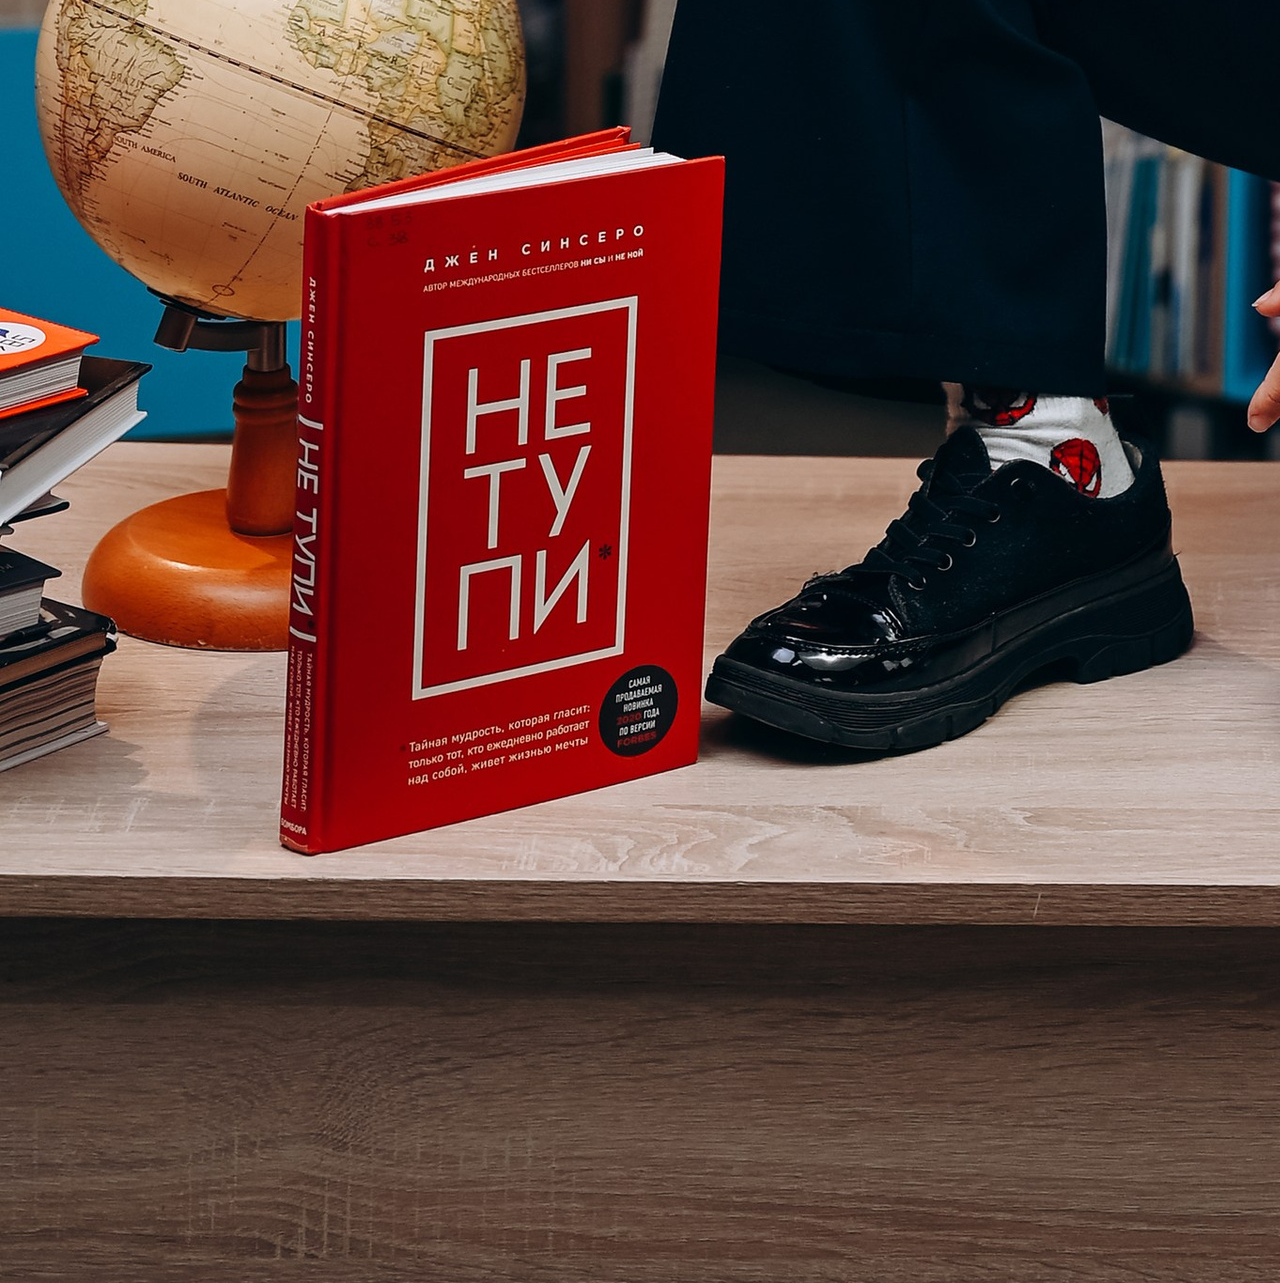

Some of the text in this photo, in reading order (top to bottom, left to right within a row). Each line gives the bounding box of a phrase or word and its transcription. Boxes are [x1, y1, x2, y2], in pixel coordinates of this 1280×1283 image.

[113, 133, 176, 163] SOUTH AMERICA
[177, 171, 299, 223] SOUTH ATLANTIC OCEAN
[423, 247, 644, 293] АВТОР МЕЖДУНАРОДНЫХ БЕСТСЕЛЛЕРОВ НИ СЫ И НЕ НОЙ
[424, 225, 644, 273] ДЖЕН СИНСЕРО
[305, 276, 317, 404] ДЖЕН СИНСЕРО
[466, 347, 592, 454] НЕ
[464, 445, 592, 549] ТУ
[292, 437, 319, 617] НЕ ТУПИ
[458, 539, 590, 650] ПИ
[615, 684, 662, 703] ПРОДАВАЕМАЯ
[623, 697, 654, 713] НОВИНКА
[628, 675, 651, 689] САМАЯ
[409, 703, 591, 753] Тайная мудрость, которая гласит:
[616, 707, 660, 726] 2020 ГОДА
[617, 731, 657, 748] FORBES
[619, 719, 656, 737] ПО ВЕРСИИ
[302, 737, 310, 777] КОТОРАЯ
[408, 719, 591, 769] только тот, кто ежедневно работает
[408, 735, 589, 786] над собой, живет жизнью мечты
